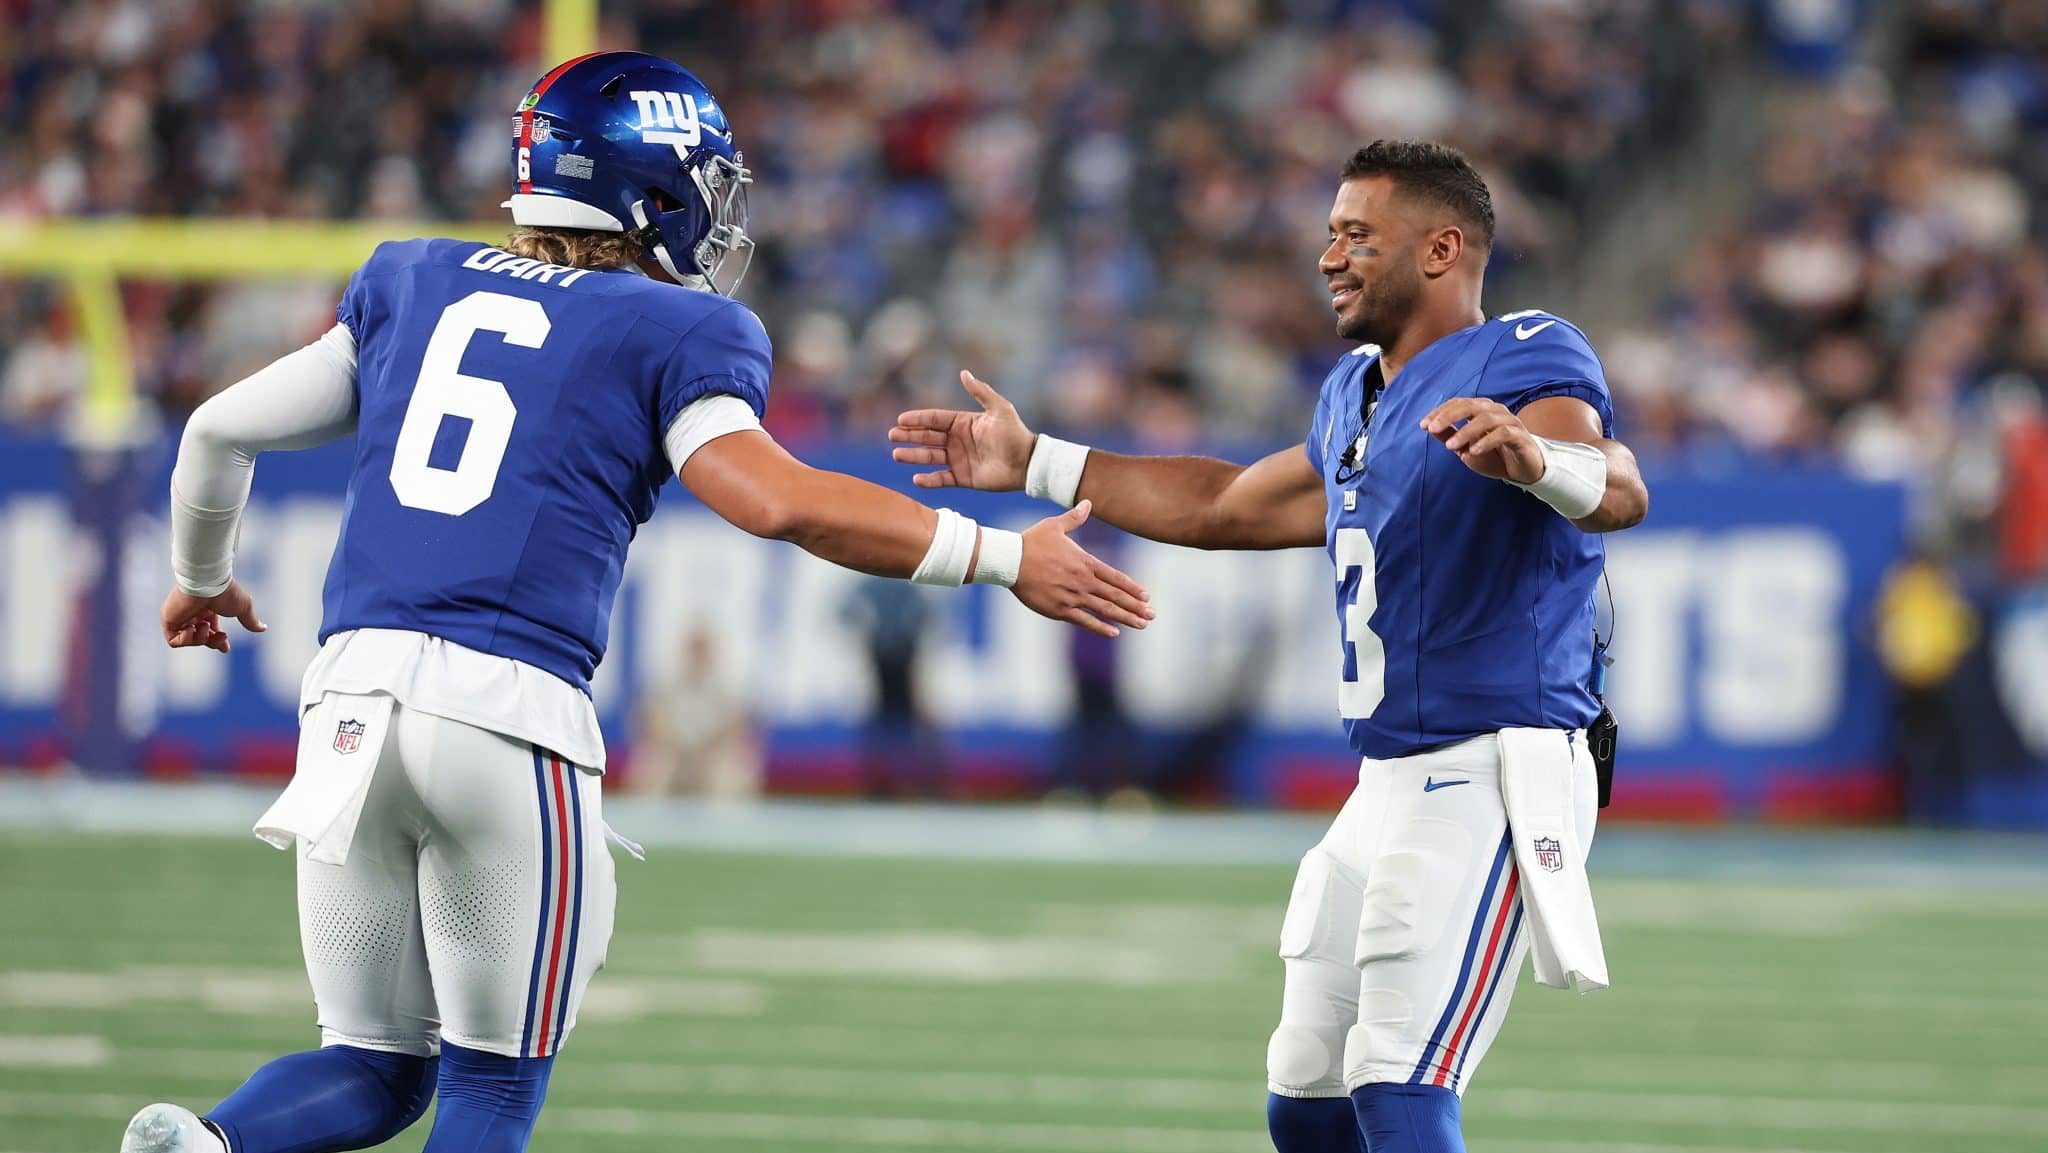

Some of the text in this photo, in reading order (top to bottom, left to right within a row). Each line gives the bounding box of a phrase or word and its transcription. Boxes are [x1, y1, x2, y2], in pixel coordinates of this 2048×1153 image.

[518, 147, 530, 180] 6
[462, 247, 596, 288] DART
[389, 290, 551, 516] 6
[1335, 528, 1386, 719] 3
[336, 733, 357, 750] NFL
[1540, 852, 1560, 868] NFL
